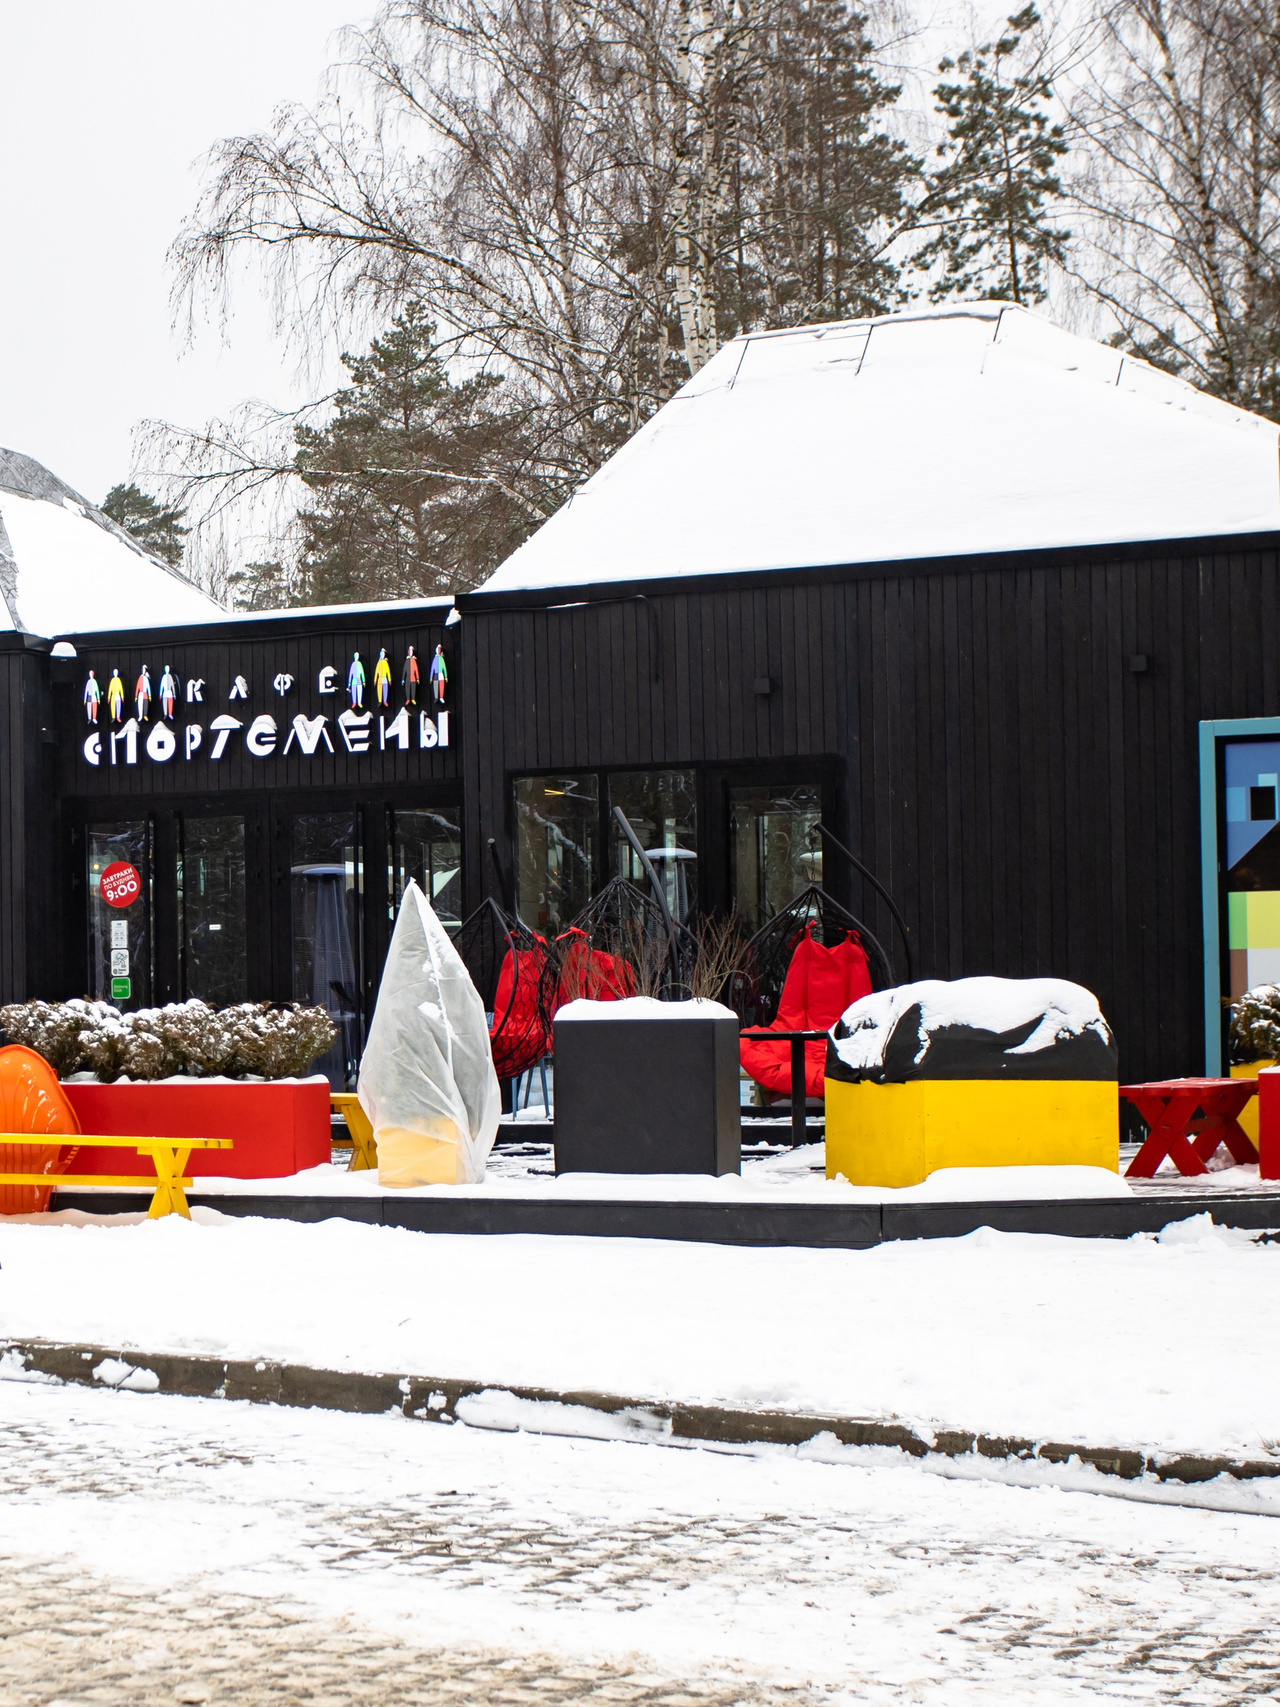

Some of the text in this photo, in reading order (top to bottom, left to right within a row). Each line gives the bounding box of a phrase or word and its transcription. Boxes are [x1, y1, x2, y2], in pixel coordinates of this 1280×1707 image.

[186, 665, 338, 702] КАФЕ
[81, 707, 447, 765] СПОРТСМЕНЫ
[102, 867, 133, 885] ЗАВТРАКИ
[103, 883, 113, 891] ПО
[106, 880, 137, 901] 9:00
